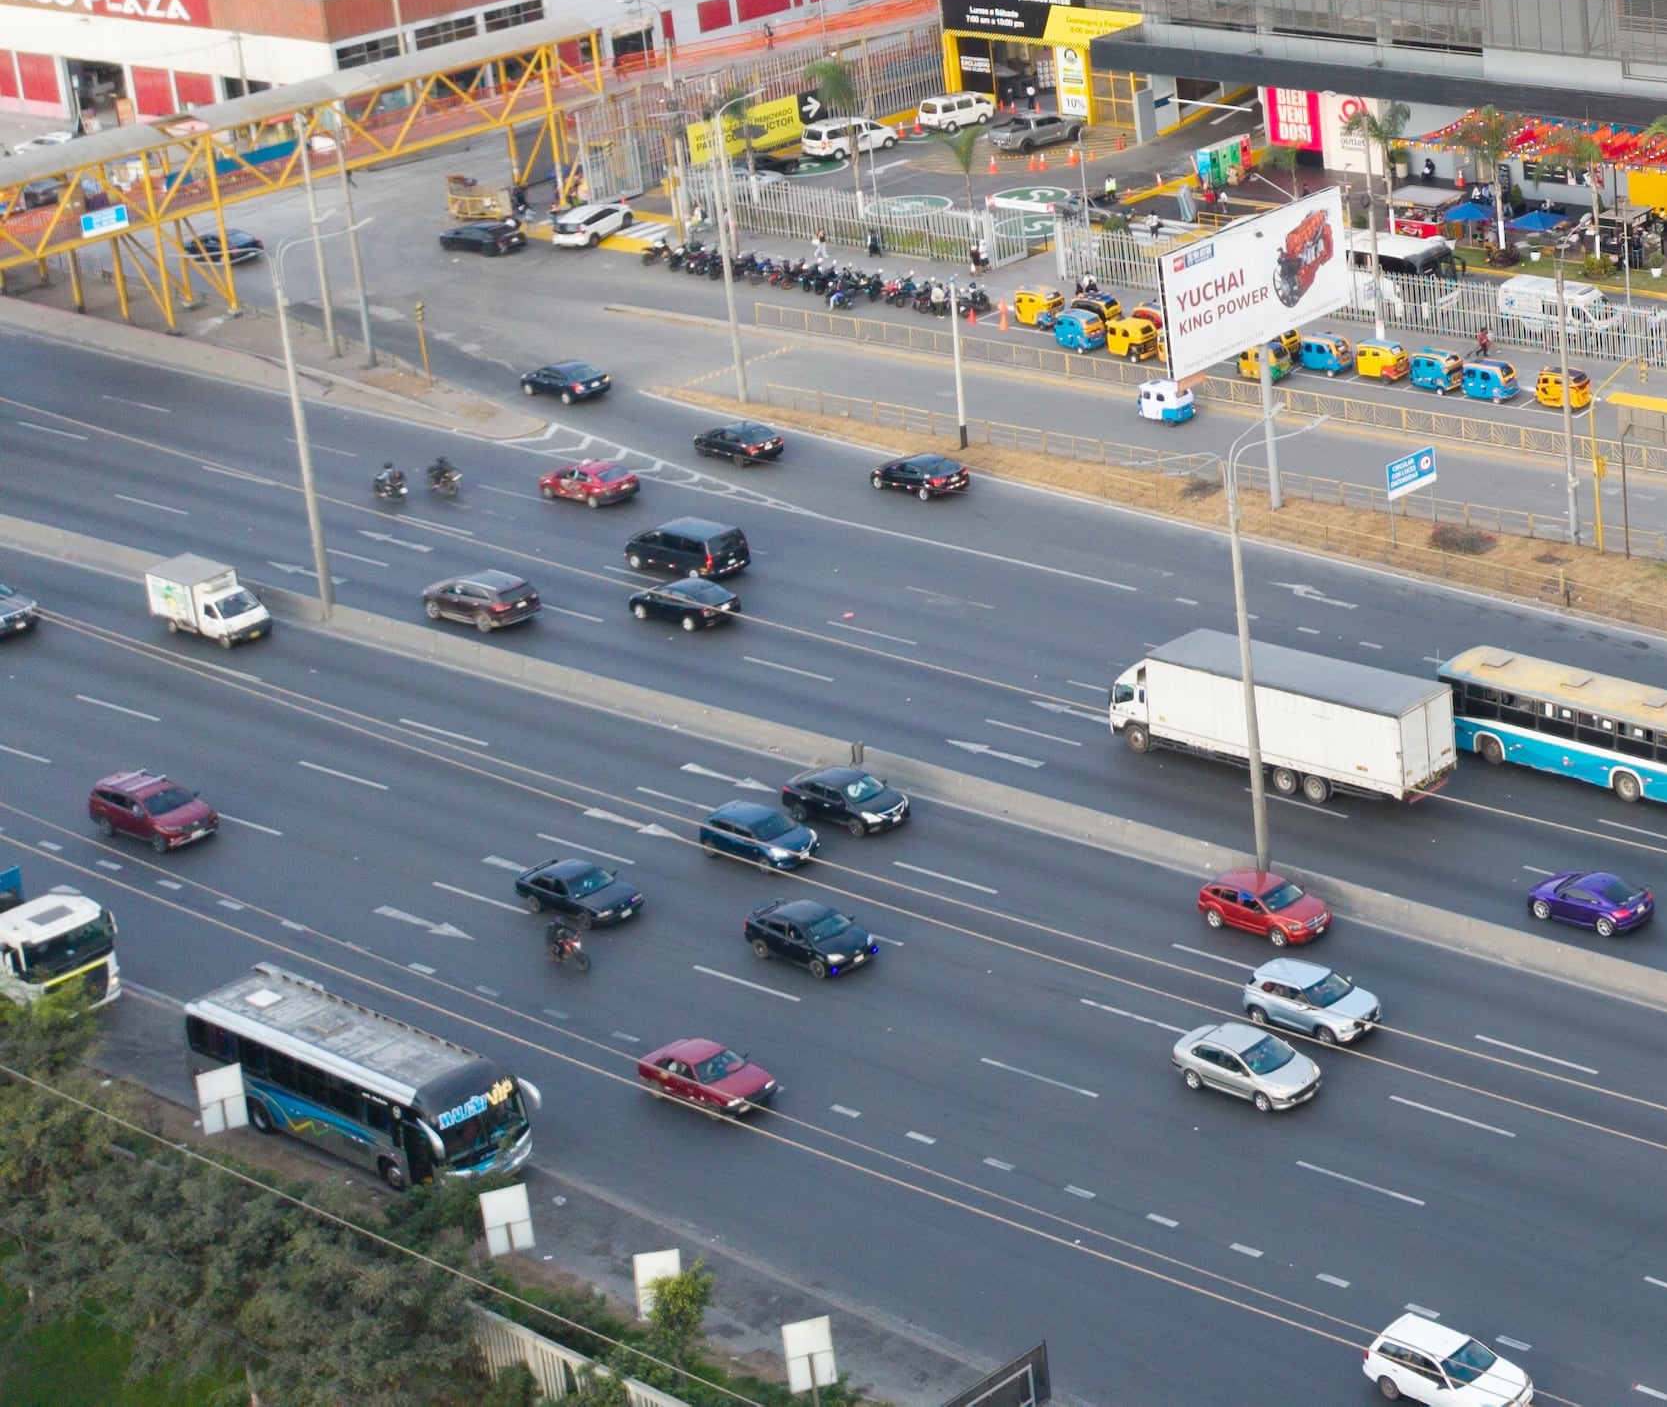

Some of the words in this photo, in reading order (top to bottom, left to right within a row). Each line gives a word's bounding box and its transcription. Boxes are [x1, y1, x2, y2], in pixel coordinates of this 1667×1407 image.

[969, 5, 987, 16] Lunes
[1276, 88, 1307, 105] BIEN
[1278, 104, 1308, 124] VENI
[1279, 122, 1312, 143] DOS!
[1176, 268, 1246, 312] YUCHAI
[1178, 308, 1213, 337] KING
[1217, 285, 1269, 320] POWER
[485, 1076, 513, 1106] VIP
